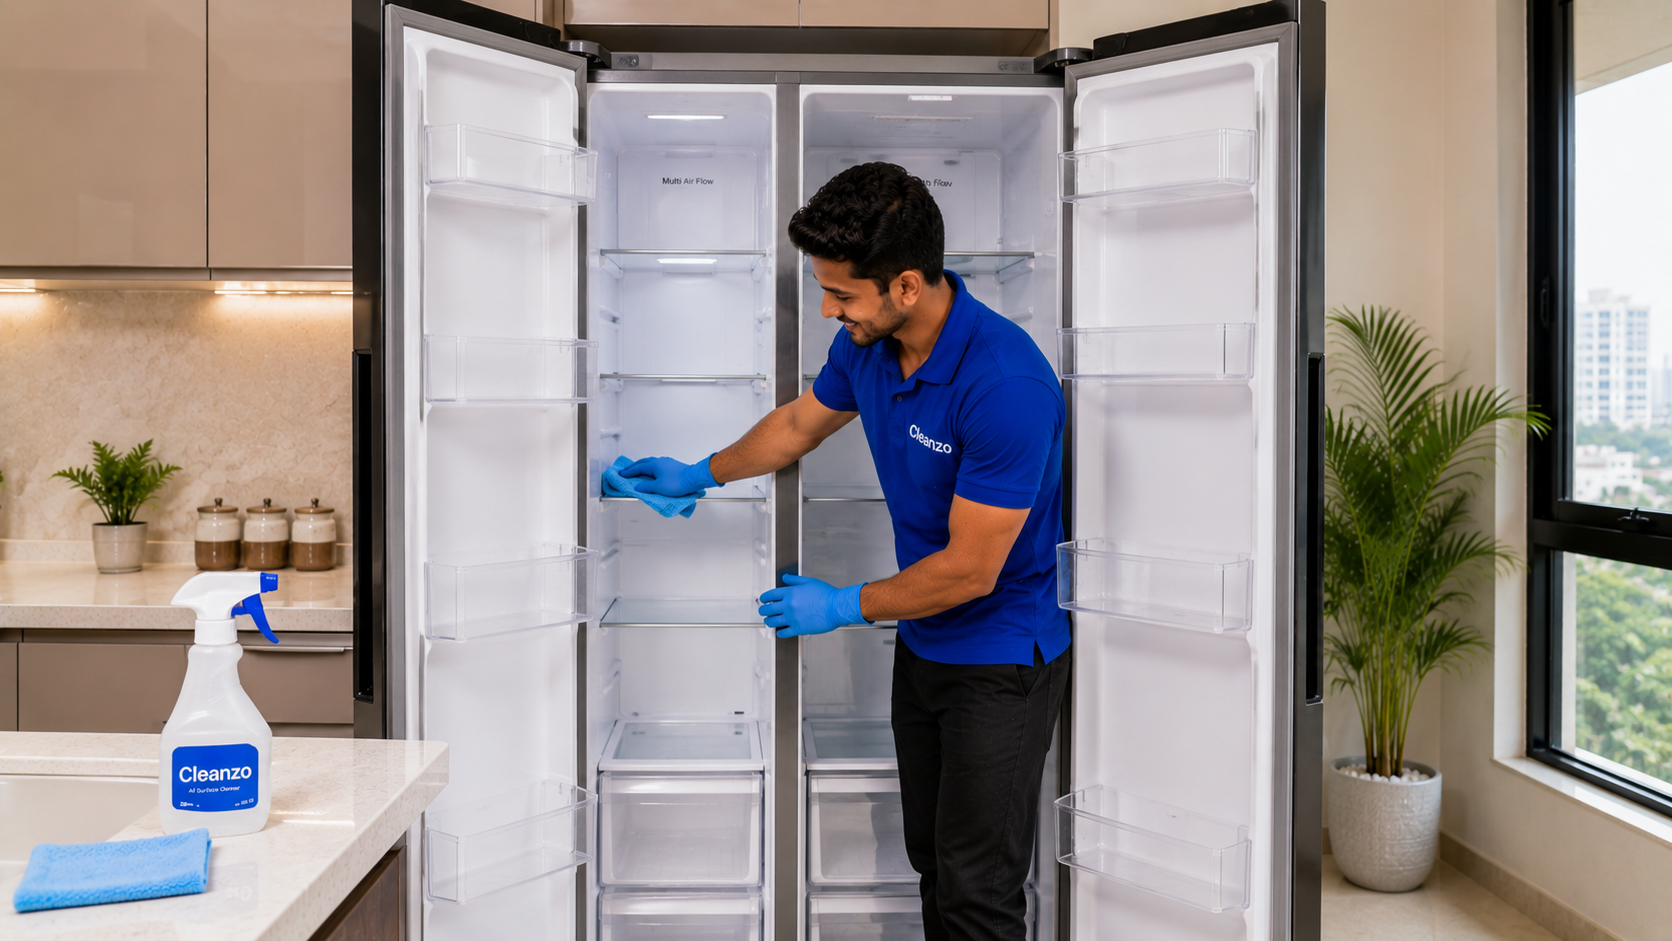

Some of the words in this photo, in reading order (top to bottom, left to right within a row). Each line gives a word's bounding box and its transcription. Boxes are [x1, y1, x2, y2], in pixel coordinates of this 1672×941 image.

[662, 177, 682, 185] Multi
[695, 177, 715, 185] Flow
[909, 424, 952, 454] Cleanzo
[179, 765, 253, 783] Cleanzo
